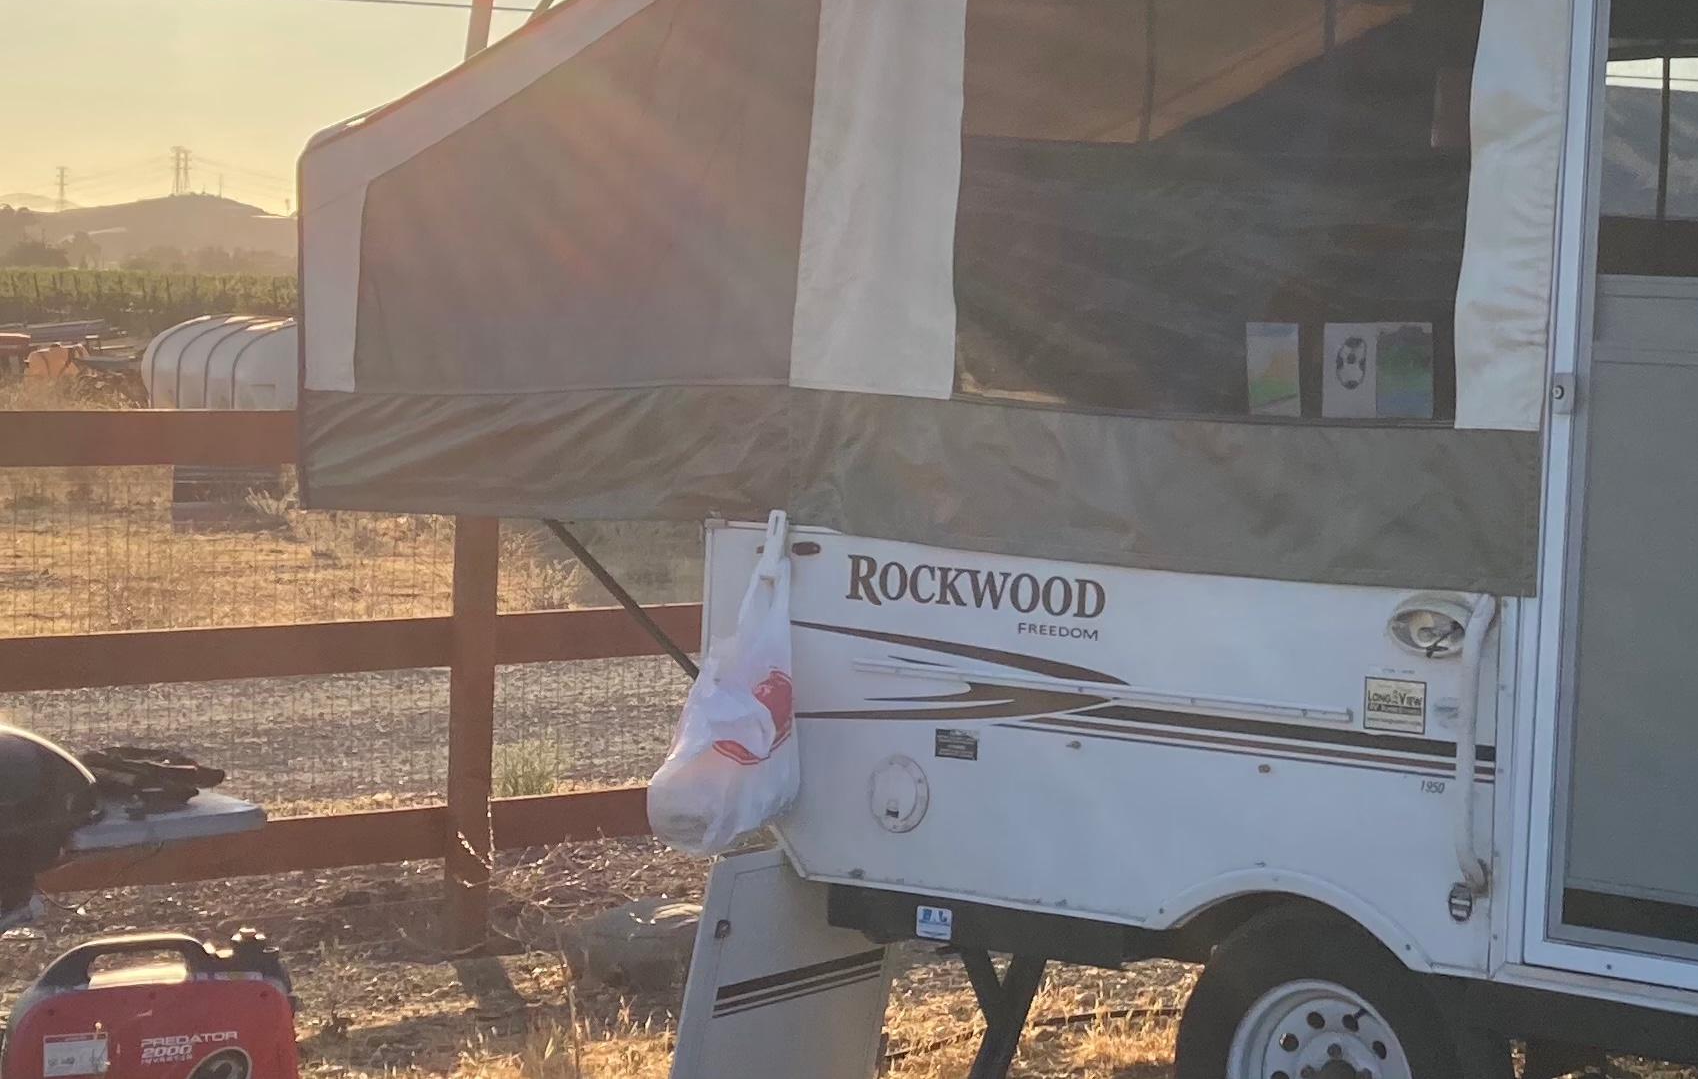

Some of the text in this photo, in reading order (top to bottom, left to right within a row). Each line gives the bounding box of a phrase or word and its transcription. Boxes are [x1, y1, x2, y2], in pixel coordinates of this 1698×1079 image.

[845, 555, 1105, 618] ROCKWOOD
[1018, 623, 1098, 641] FREEDOM
[1421, 780, 1445, 794] 1950
[141, 1031, 238, 1048] PREDATOR
[142, 1044, 193, 1059] 2000
